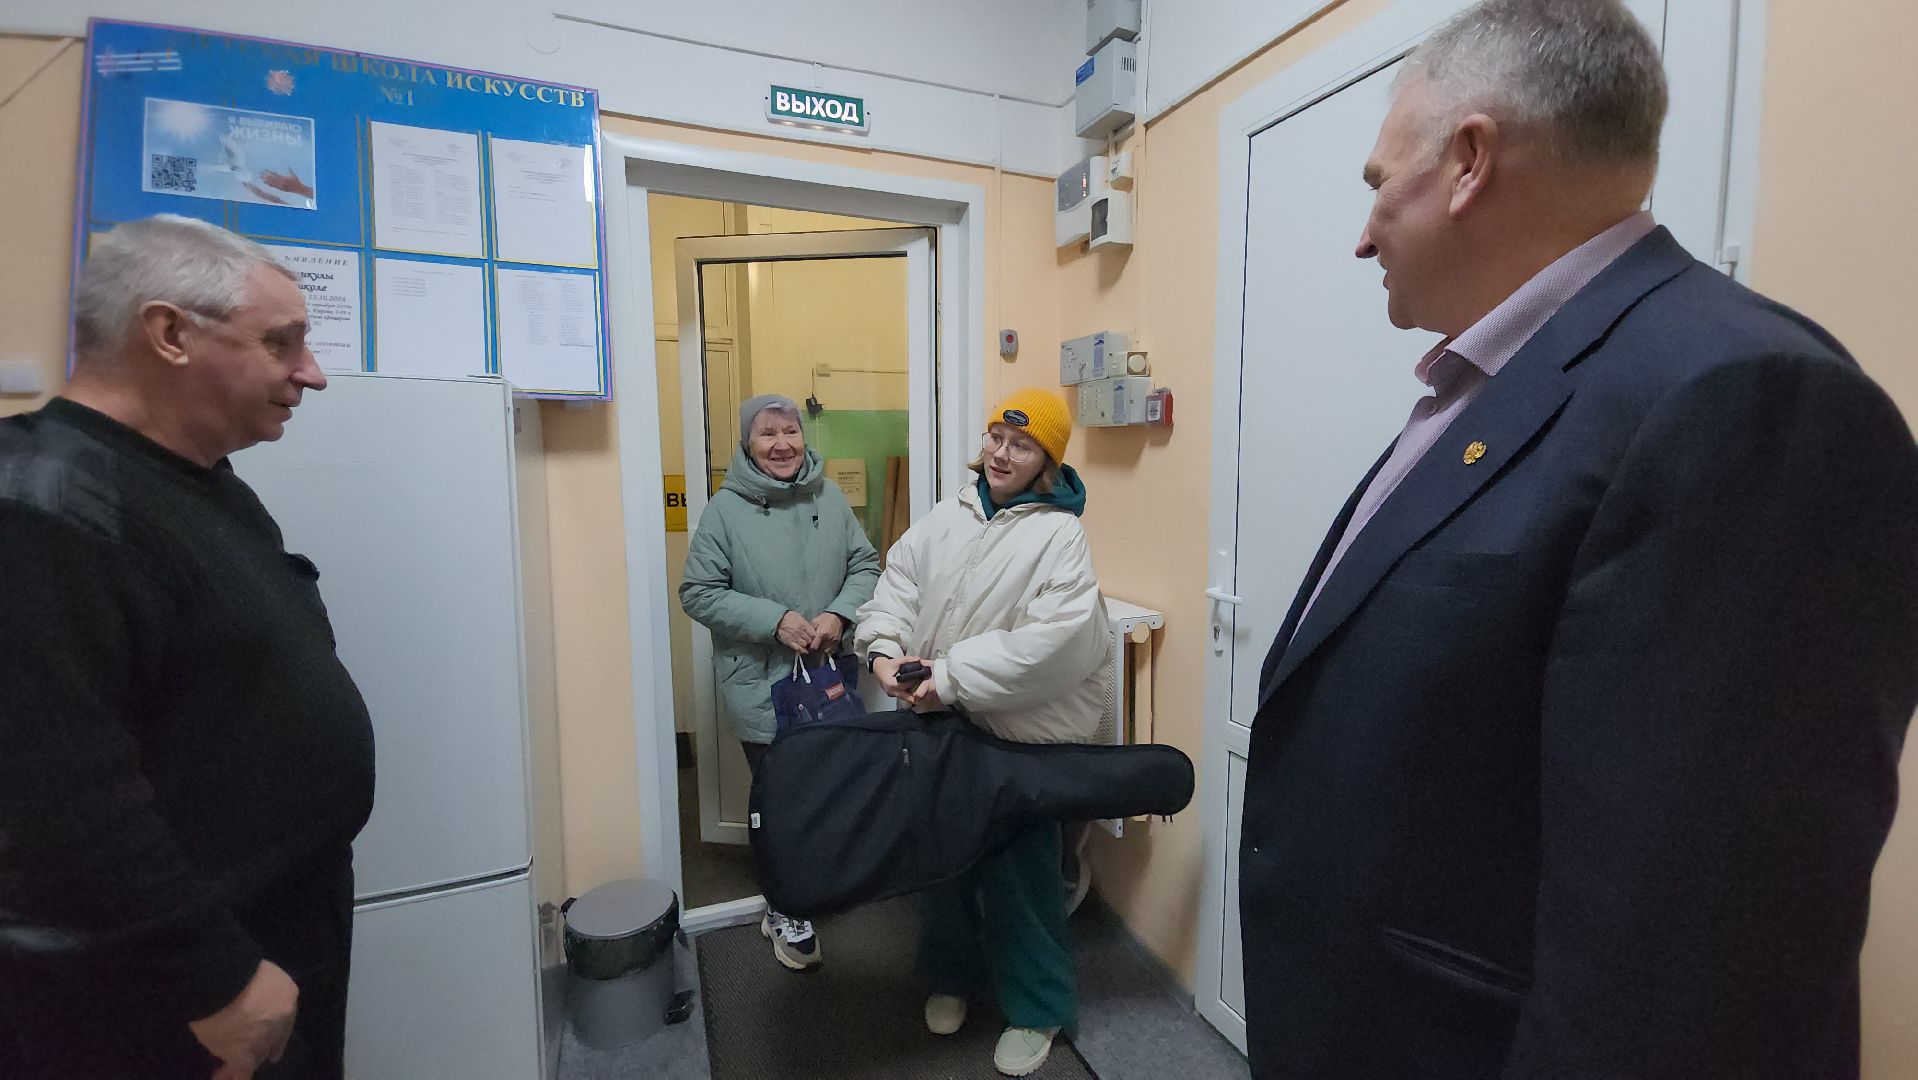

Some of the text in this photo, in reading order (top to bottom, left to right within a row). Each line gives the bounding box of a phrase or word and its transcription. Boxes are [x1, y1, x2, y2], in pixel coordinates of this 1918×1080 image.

[332, 52, 437, 86] ШКОЛА
[446, 70, 585, 108] ИСКУССТВ
[377, 86, 414, 106] №1
[776, 91, 859, 123] ВЫХОД
[239, 117, 302, 133] ВЫБИРАЮ
